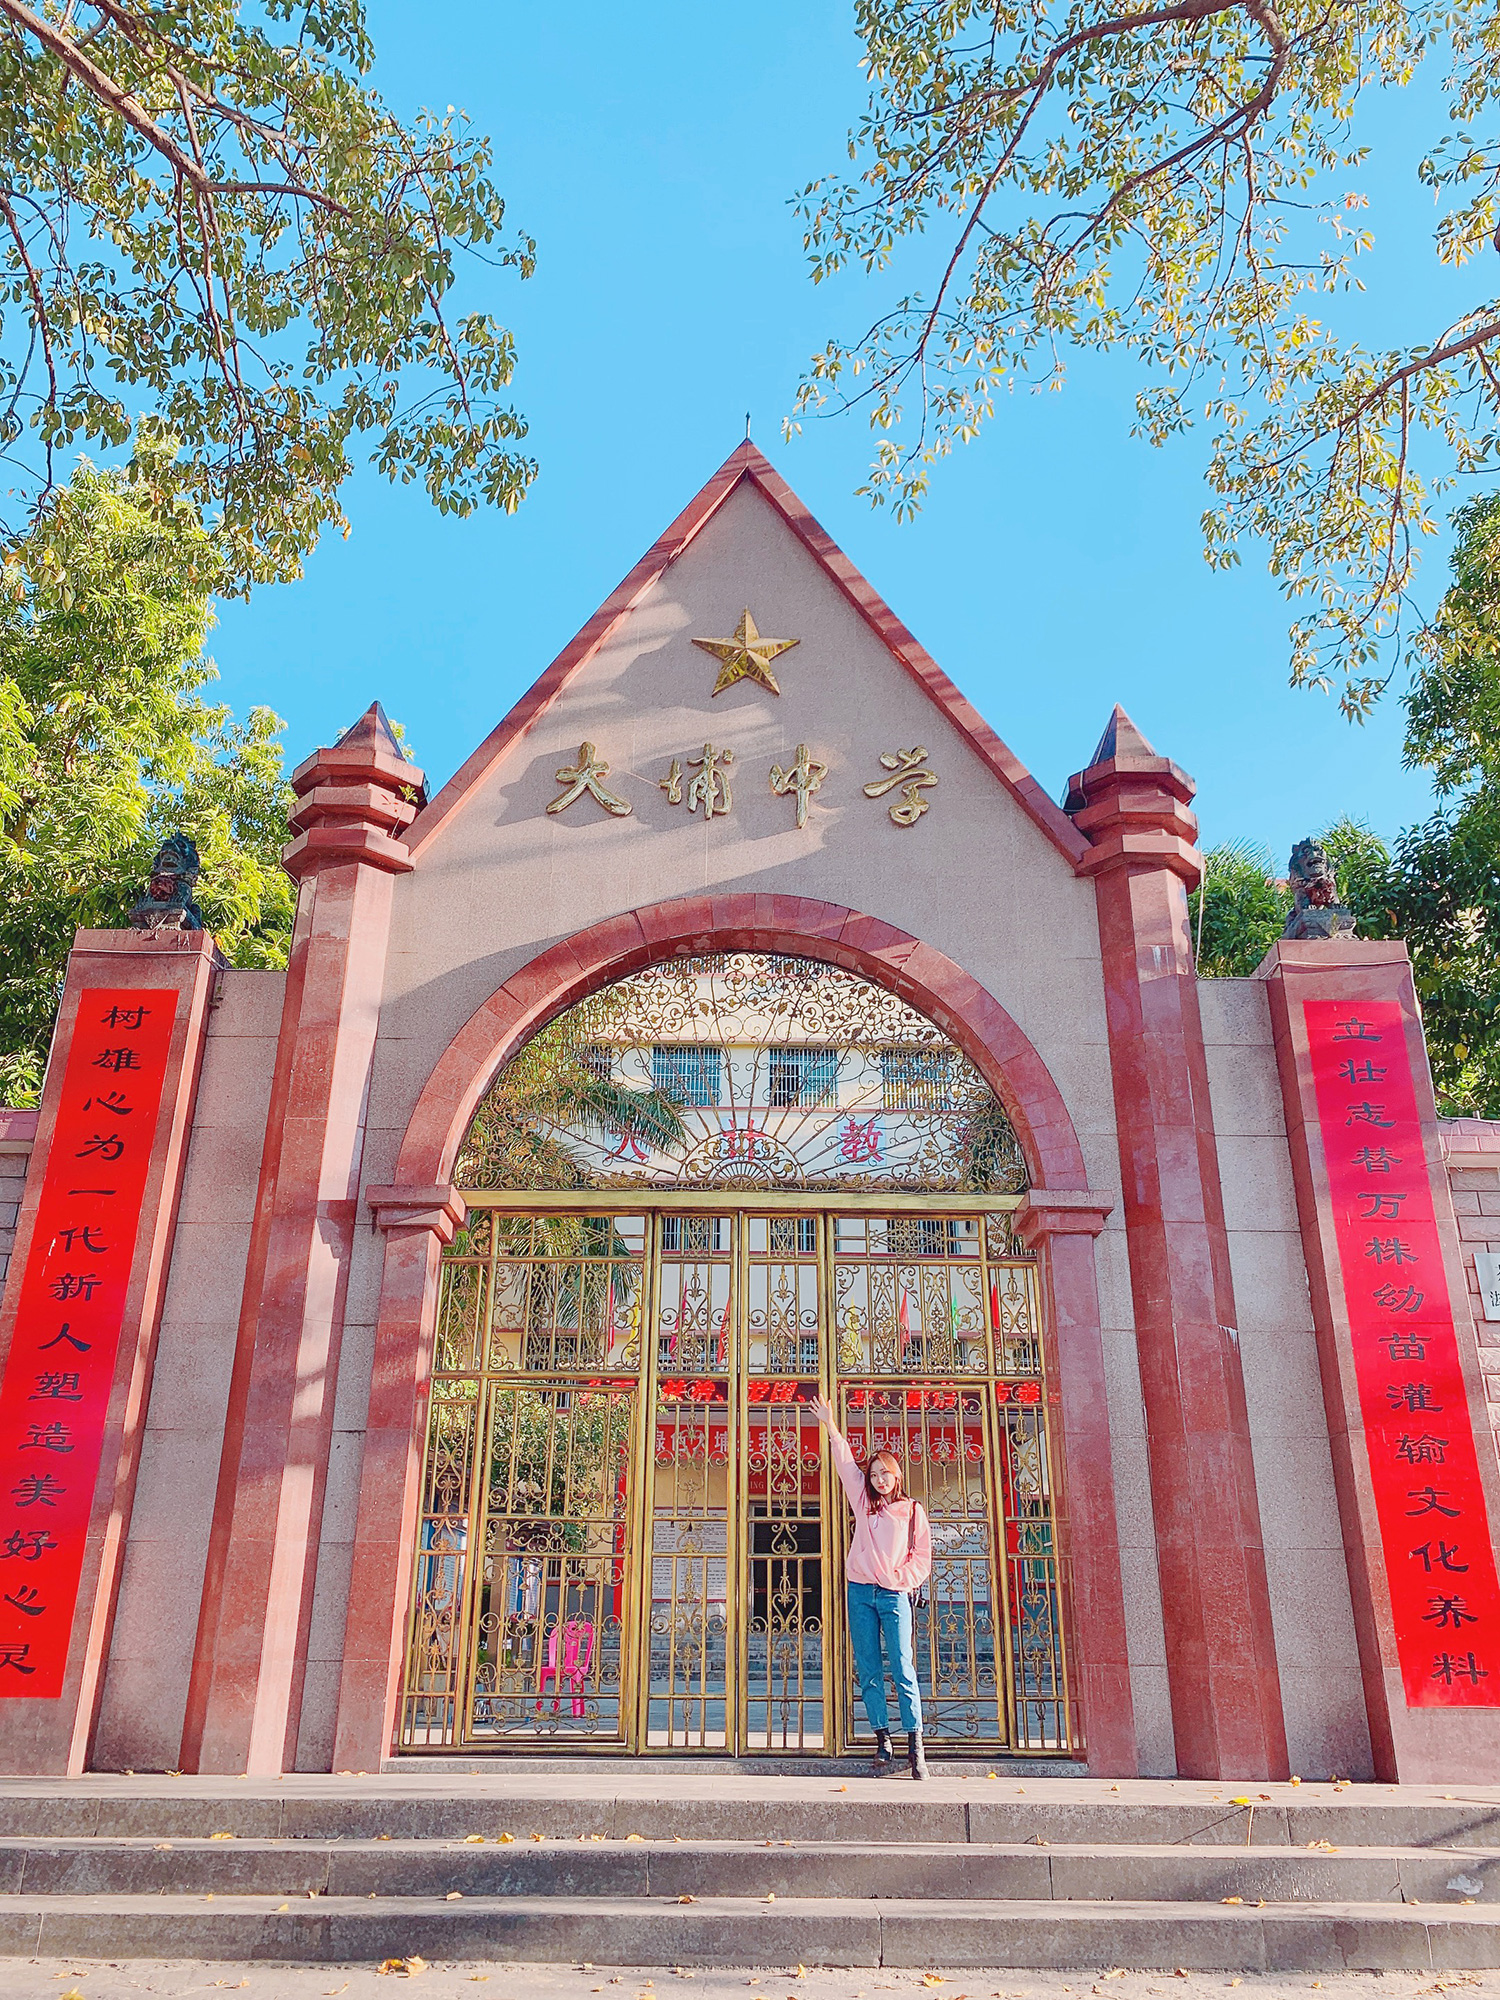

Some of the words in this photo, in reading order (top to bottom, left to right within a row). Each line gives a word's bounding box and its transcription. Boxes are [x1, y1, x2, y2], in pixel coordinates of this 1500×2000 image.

[546, 742, 938, 829] 大埔中学
[0, 1005, 152, 1674] 树雄心为一代新人塑造美好心灵
[1333, 1017, 1488, 1686] 立壮志替万株幼苗灌输文化养料
